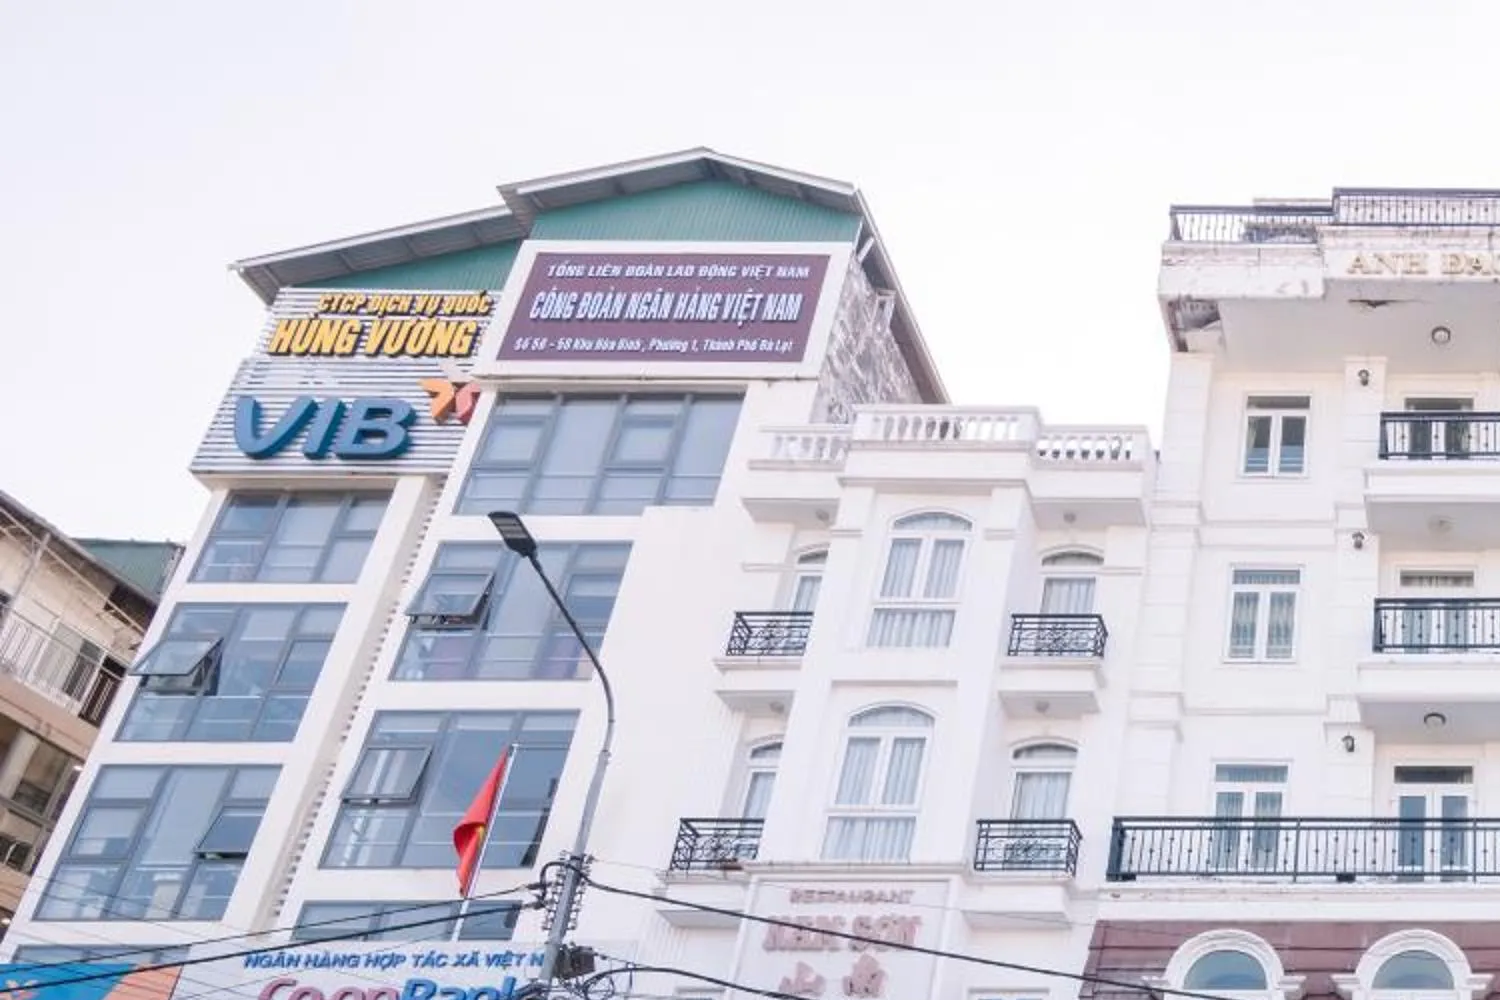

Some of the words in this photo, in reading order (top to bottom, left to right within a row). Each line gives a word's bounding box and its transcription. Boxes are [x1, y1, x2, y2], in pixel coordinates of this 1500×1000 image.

[587, 263, 623, 277] LIÊN
[666, 265, 695, 277] LAO
[776, 265, 811, 279] NAM
[624, 287, 675, 320] NGÂN
[673, 286, 722, 321] HÀNG
[721, 287, 764, 327] VIỆT
[761, 292, 803, 321] NAM
[234, 395, 416, 459] VIB
[243, 947, 301, 970] NGÂN
[304, 947, 361, 969] HÀNG
[363, 948, 406, 972] HỢP
[411, 947, 449, 969] TÁC
[451, 948, 480, 968] XÃ
[485, 947, 527, 971] VIỆT
